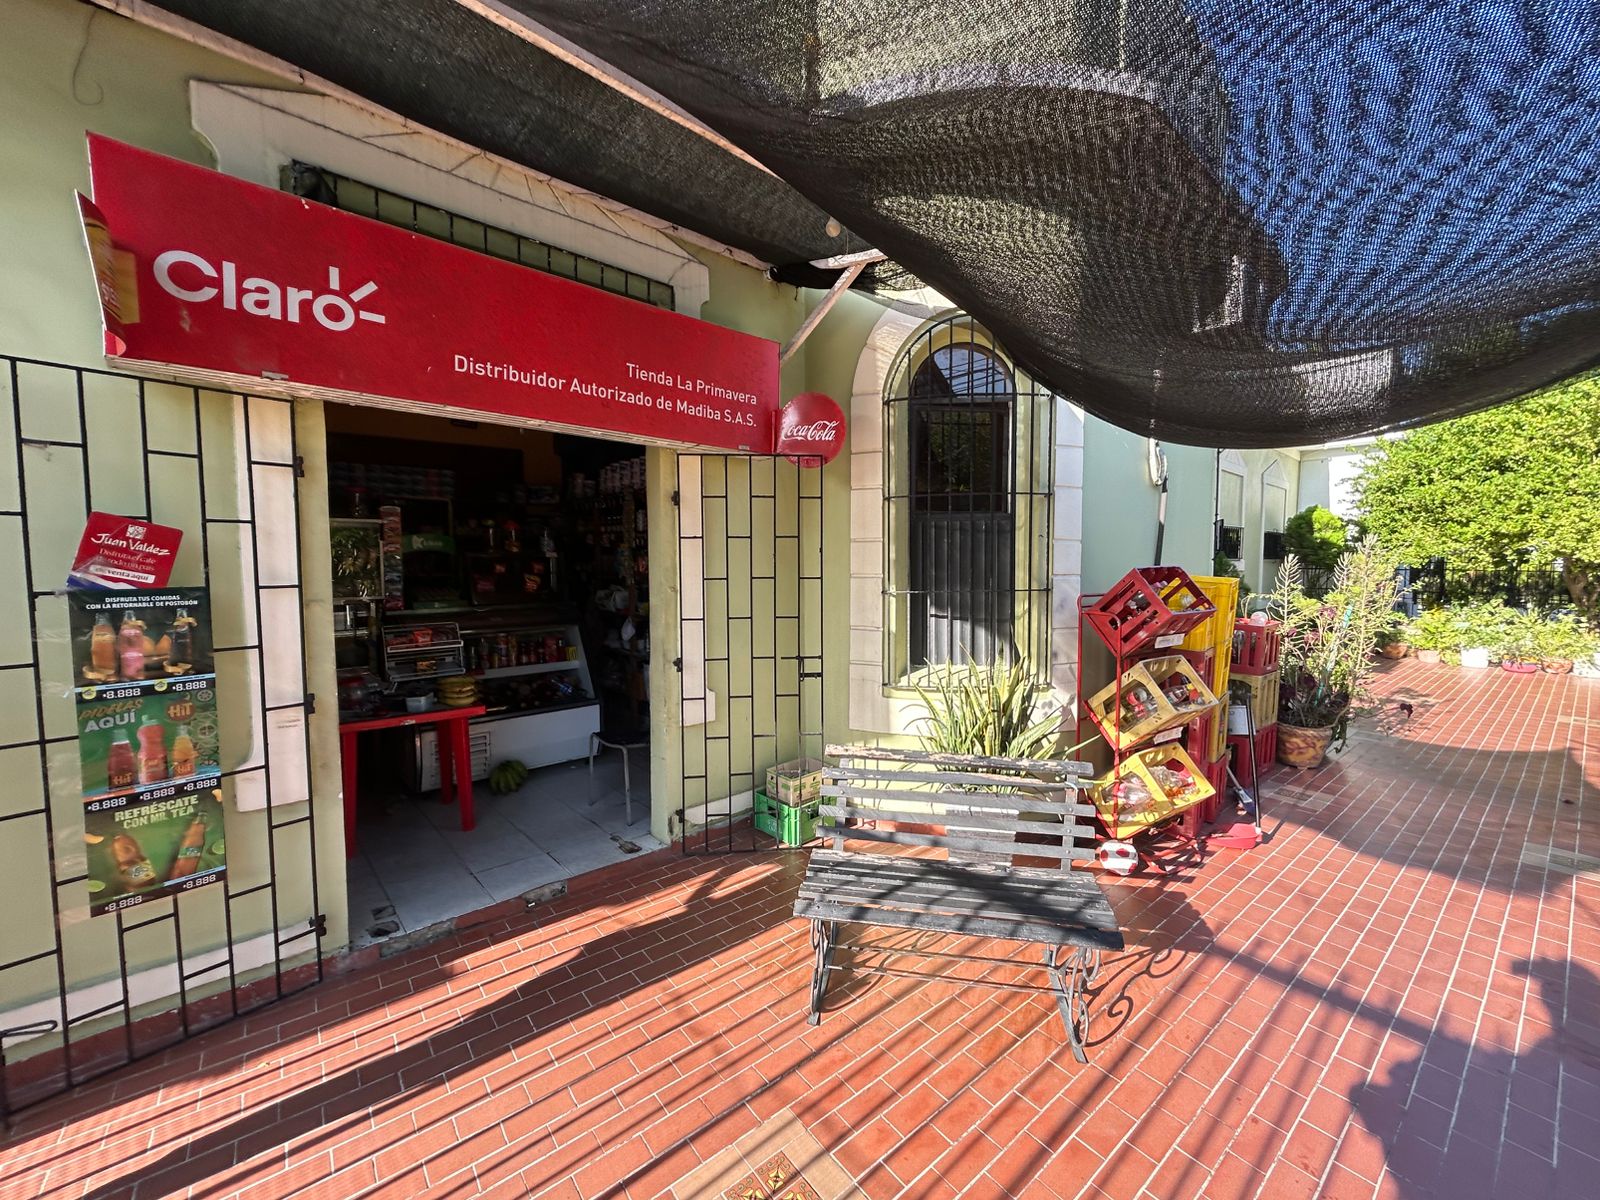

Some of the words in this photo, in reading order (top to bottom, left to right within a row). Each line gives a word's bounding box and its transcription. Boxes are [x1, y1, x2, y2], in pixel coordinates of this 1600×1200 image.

[153, 249, 357, 332] Claro
[453, 353, 567, 392] Distribuidor
[570, 376, 653, 408] Autorizado
[655, 394, 674, 412] de
[676, 398, 722, 422] Madiba
[723, 408, 758, 428] S.A.S.
[626, 362, 674, 388] Tienda
[677, 374, 694, 391] La
[696, 379, 759, 406] Primavera
[90, 533, 127, 548] Juan
[128, 539, 171, 556] Valdez
[107, 569, 130, 578] venta
[84, 709, 136, 733] AQUÍ
[114, 794, 199, 822] REFRÉSCATE
[123, 815, 147, 829] CON
[171, 805, 194, 818] TEA
